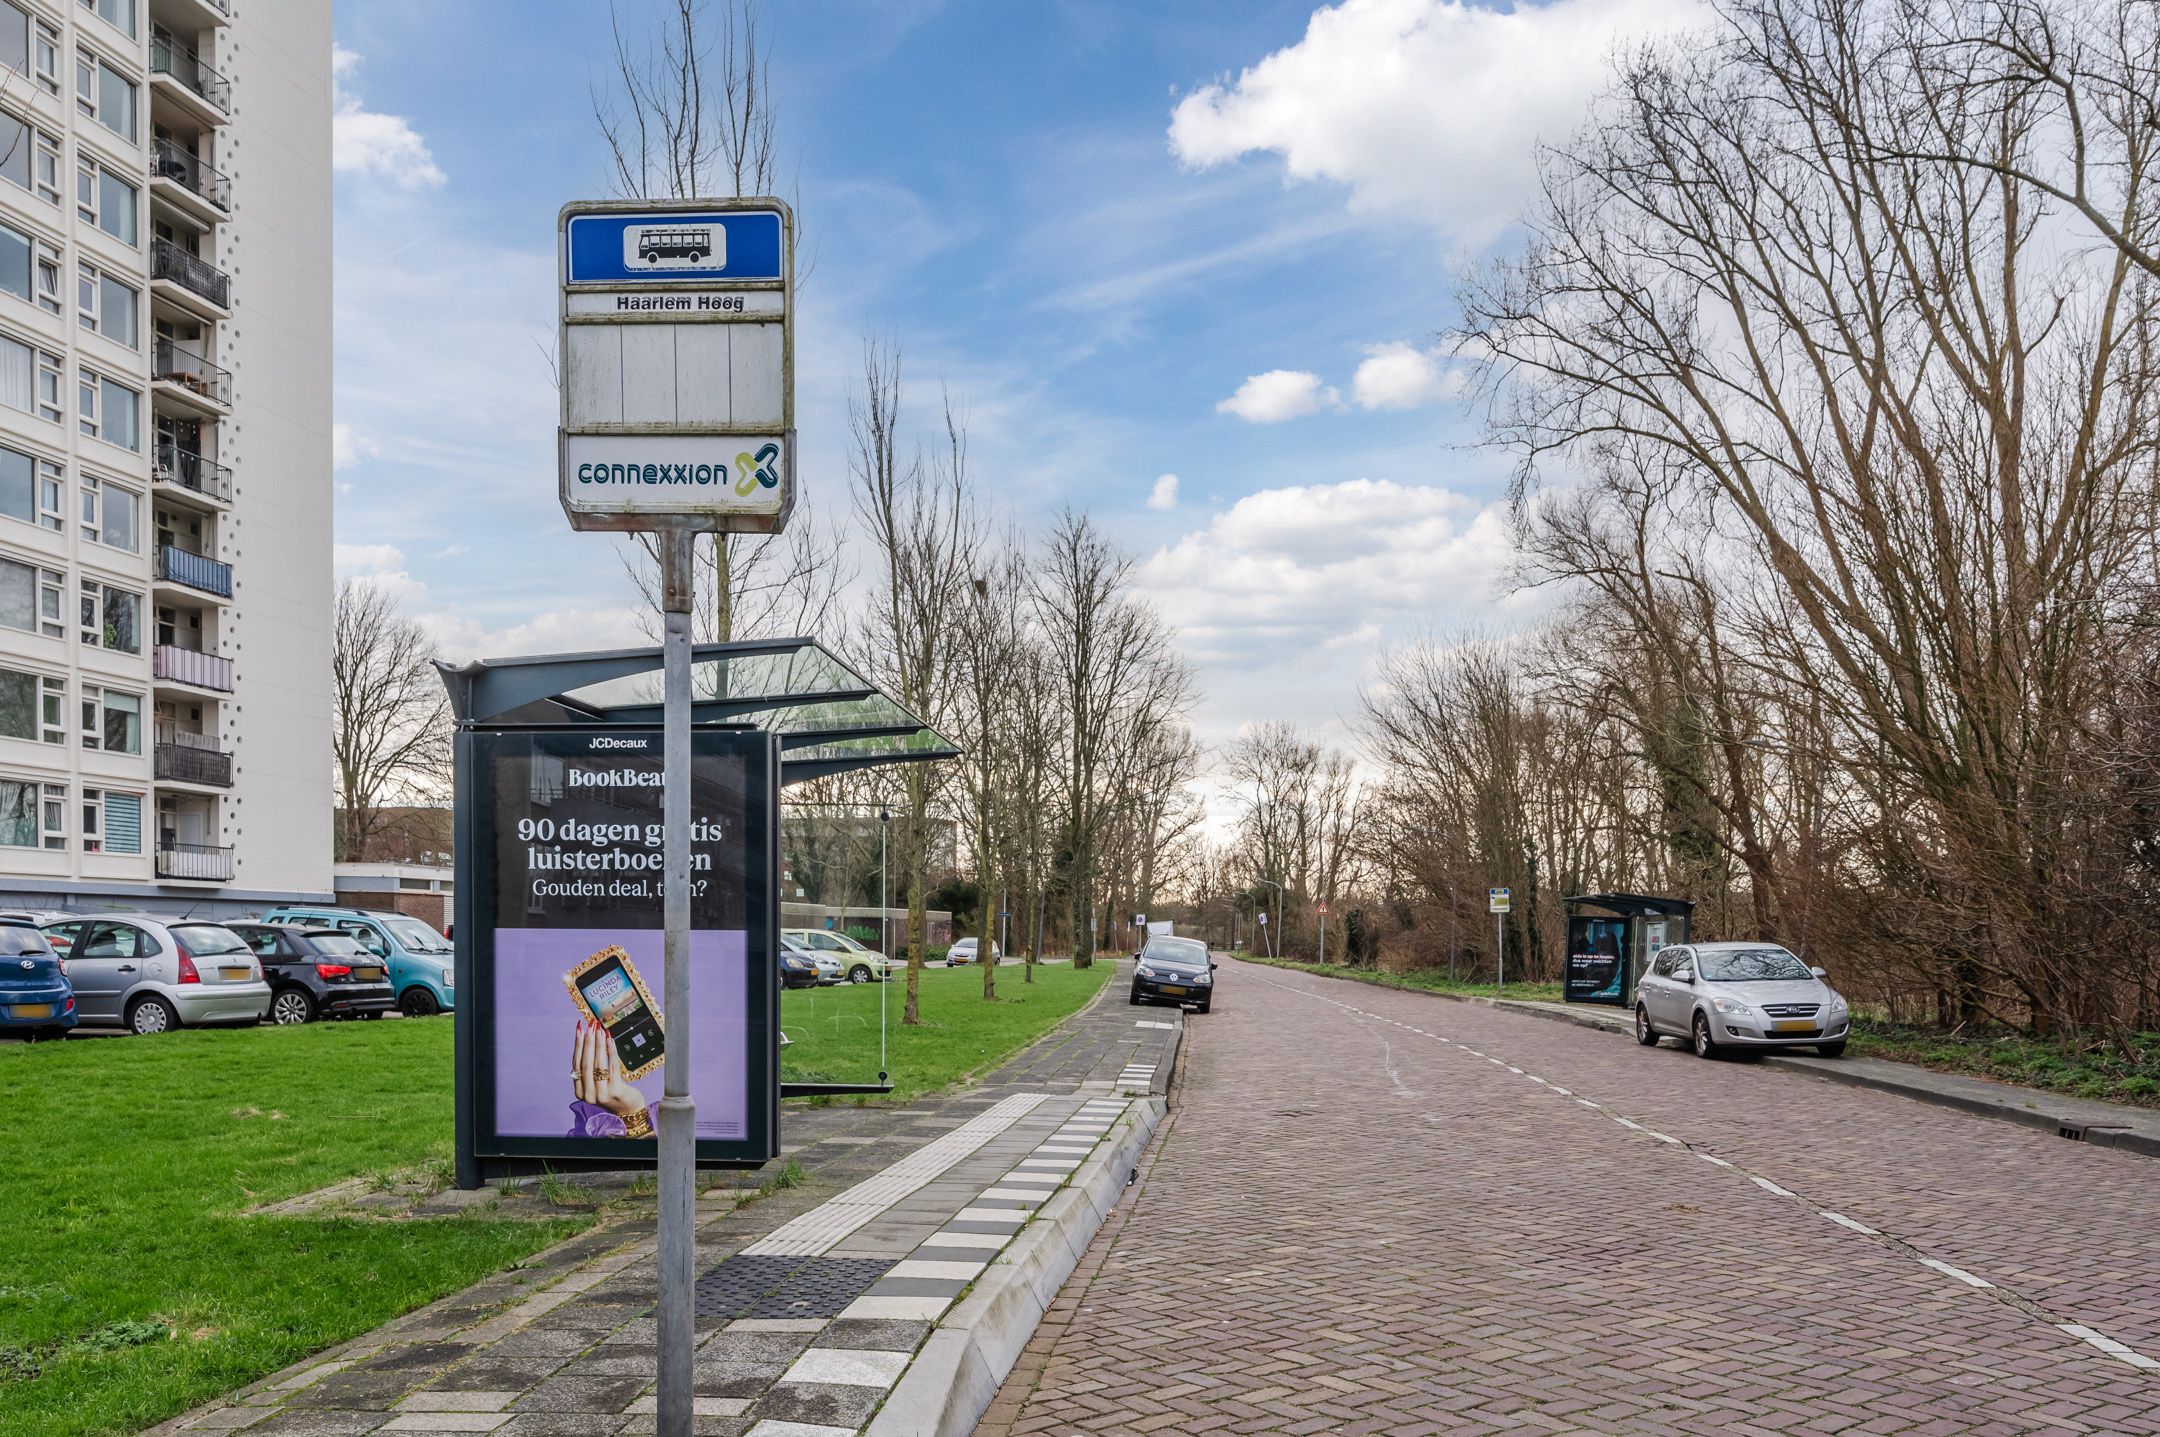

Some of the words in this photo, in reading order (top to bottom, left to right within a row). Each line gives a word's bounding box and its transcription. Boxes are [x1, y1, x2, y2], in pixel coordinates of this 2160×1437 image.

[617, 296, 692, 310] Haarlem
[697, 296, 745, 313] Hoog
[578, 463, 728, 486] connexxion
[589, 737, 648, 749] JCDecaux
[518, 818, 555, 842] 90
[560, 818, 641, 846] dagen
[644, 816, 722, 847] gtis
[527, 846, 712, 871] luisterboen
[532, 879, 605, 897] Gouden
[608, 879, 653, 899] deal,
[656, 879, 708, 897] th?
[589, 975, 621, 998] LUCINDA
[599, 984, 619, 999] RILEY
